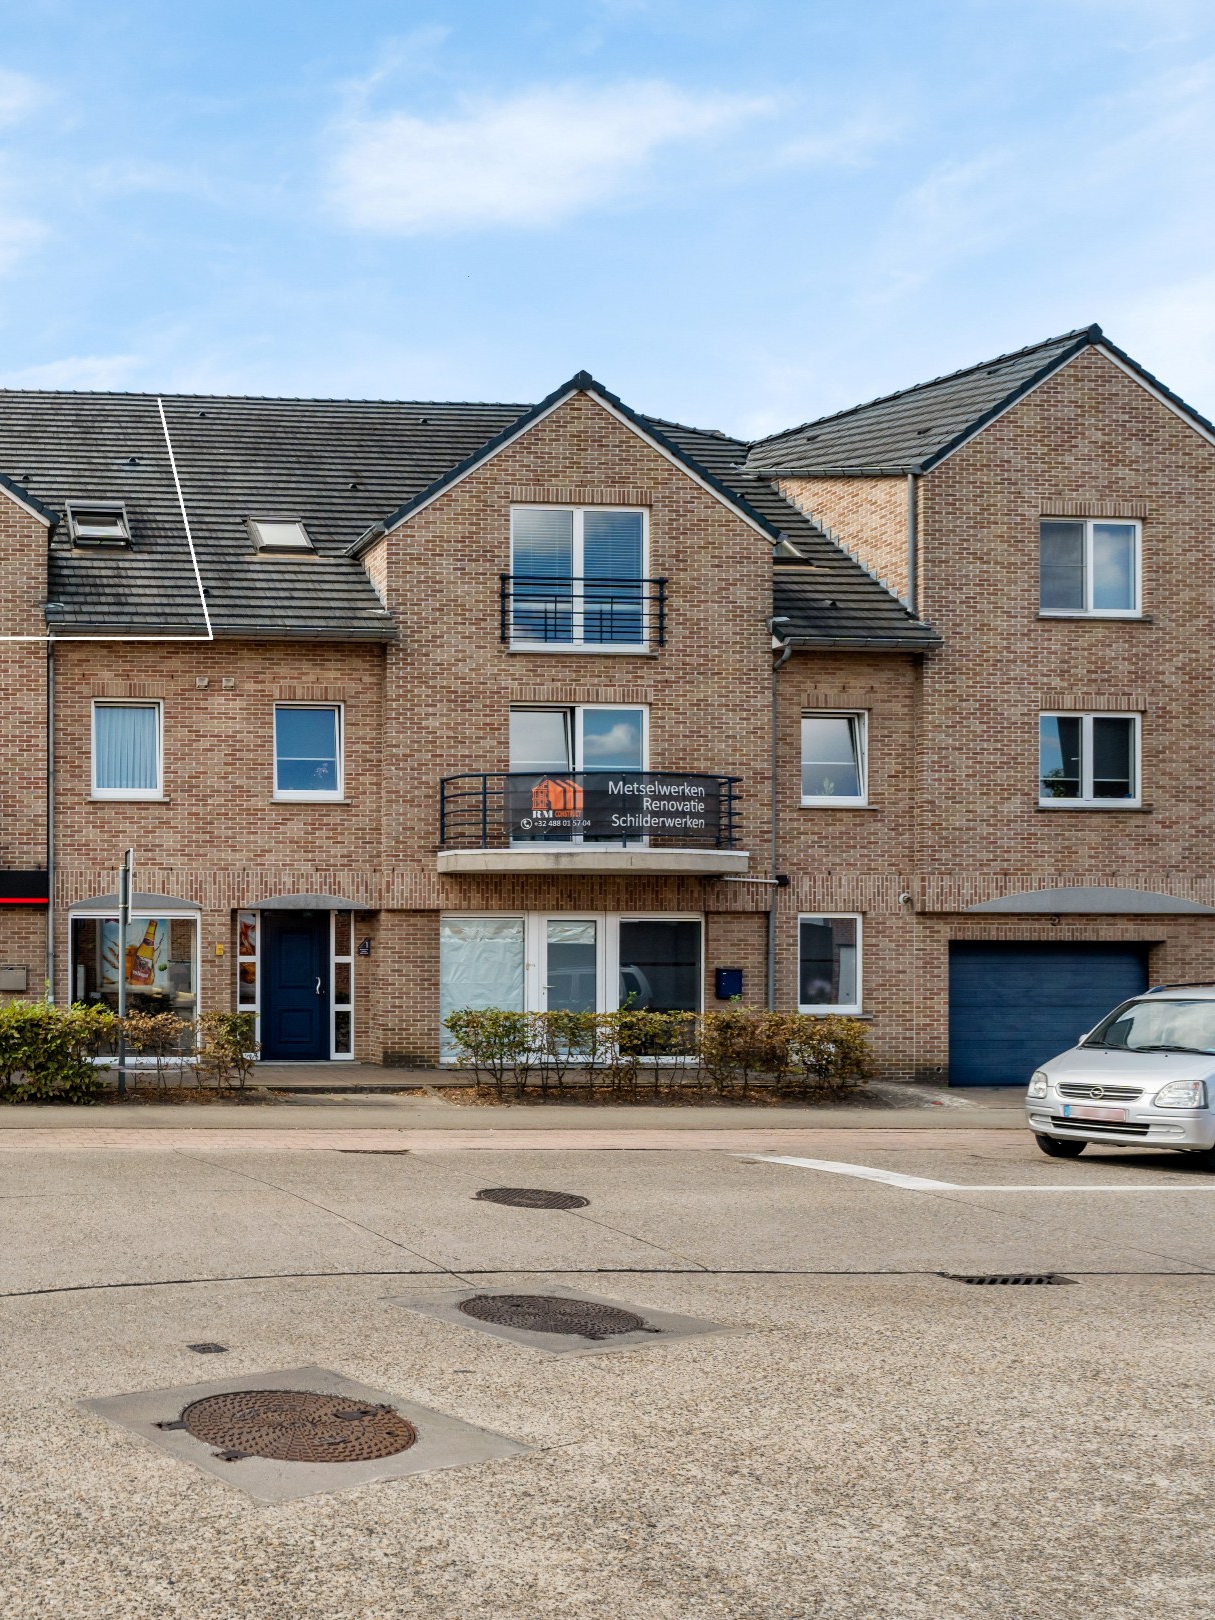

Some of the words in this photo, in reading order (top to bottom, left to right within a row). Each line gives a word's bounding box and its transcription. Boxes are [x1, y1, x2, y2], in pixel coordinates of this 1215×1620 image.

[608, 781, 705, 797] Metselwerken
[643, 797, 705, 813] Renovatie
[532, 810, 553, 818] RM
[554, 810, 581, 818] CONSTRUCT
[611, 813, 705, 829] Schilderwerken
